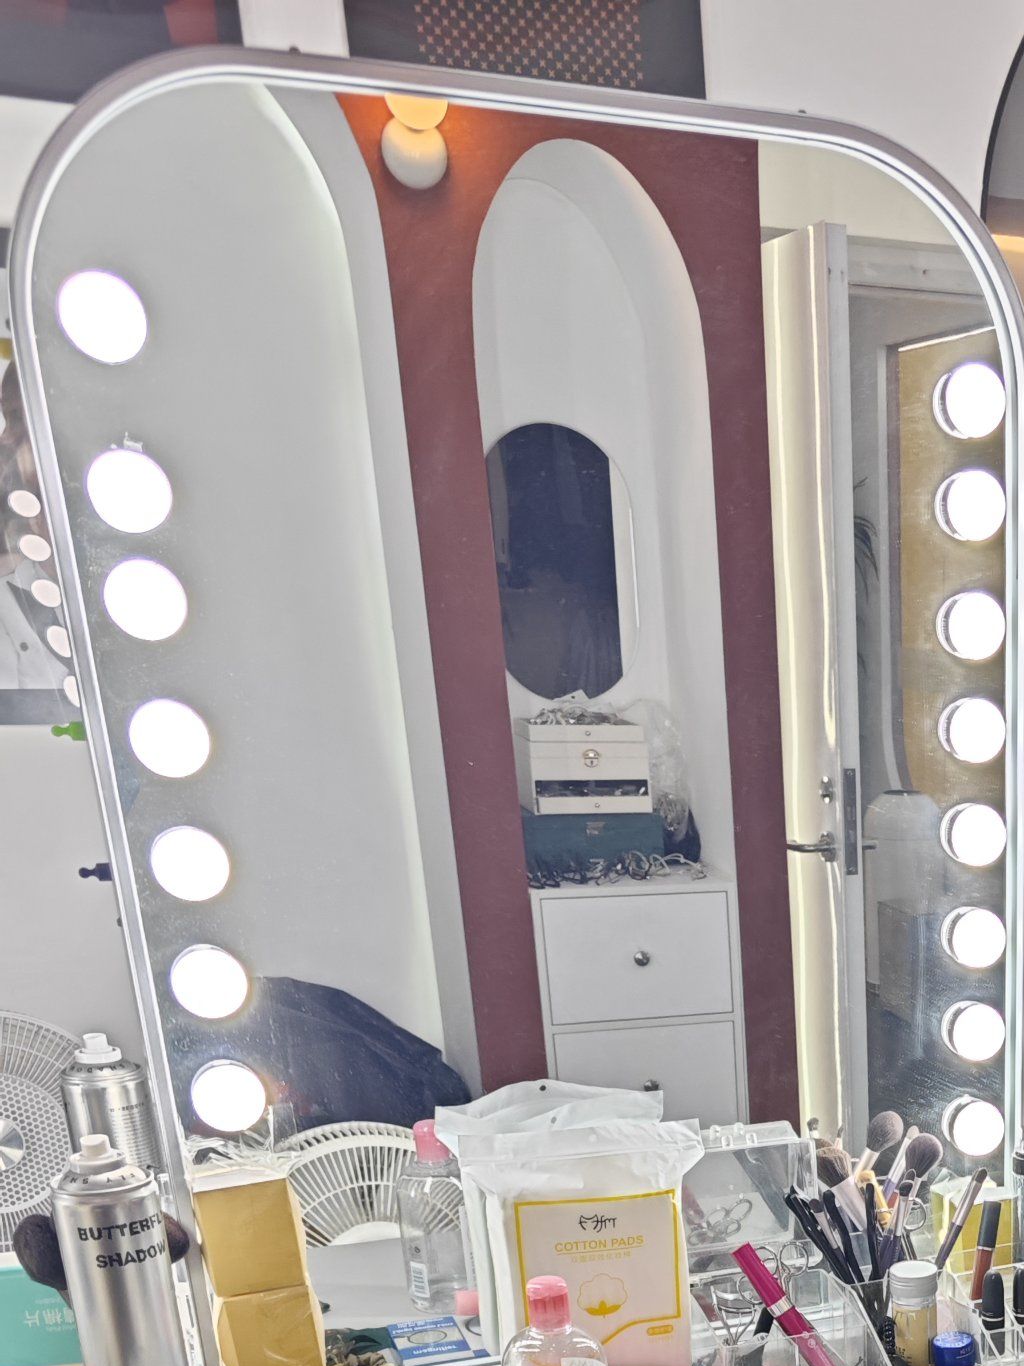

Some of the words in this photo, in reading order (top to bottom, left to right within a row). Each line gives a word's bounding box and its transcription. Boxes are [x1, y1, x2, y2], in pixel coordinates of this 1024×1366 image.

[77, 1212, 163, 1241] BUTTERFL
[95, 1239, 167, 1269] SHADOW
[554, 1239, 607, 1253] COTTON
[611, 1234, 645, 1248] PADS
